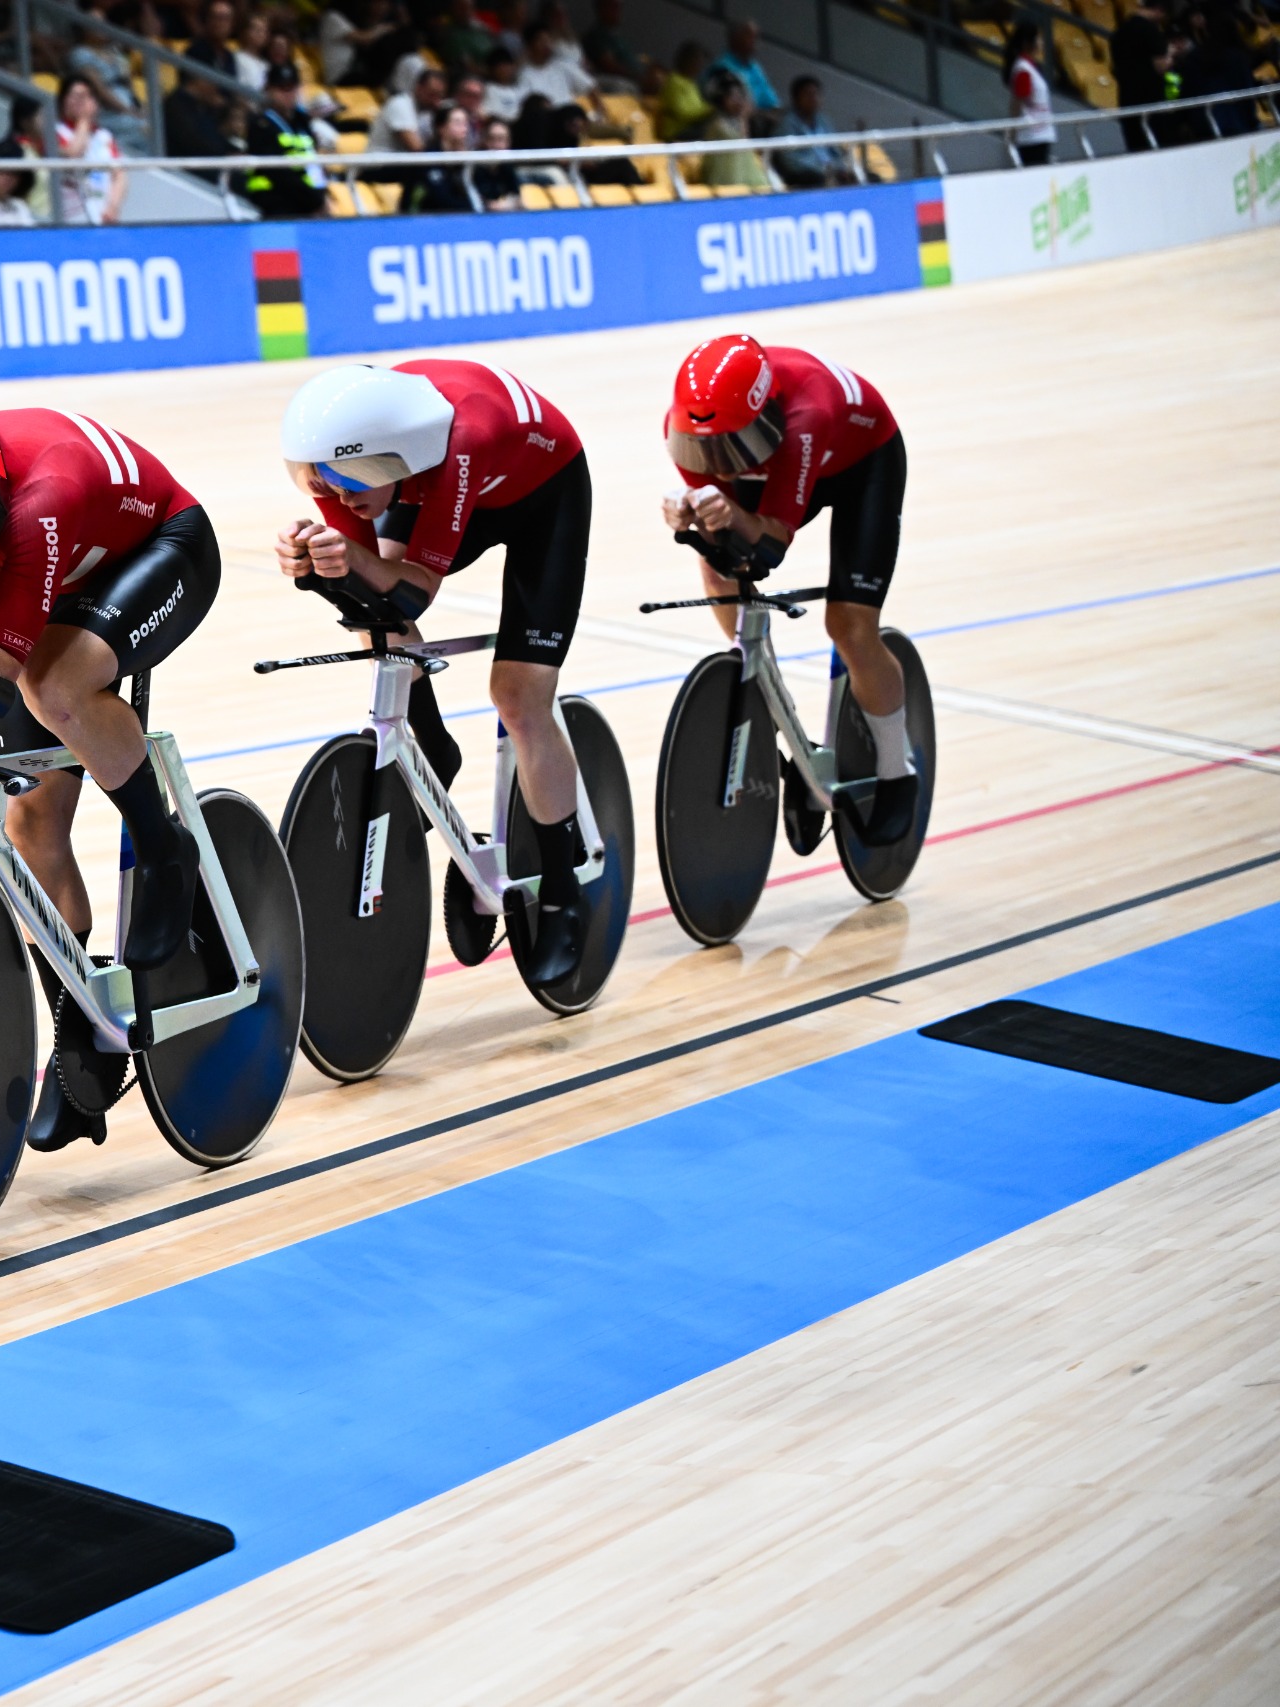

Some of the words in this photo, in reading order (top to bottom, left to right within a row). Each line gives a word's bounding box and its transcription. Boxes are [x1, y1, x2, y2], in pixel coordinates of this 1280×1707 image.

[369, 234, 593, 324] SHIMANO
[696, 208, 877, 293] SHIMANO
[119, 496, 156, 519] postnord
[452, 454, 470, 532] postnord
[38, 517, 60, 613] postnord
[3, 632, 26, 649] TEAM
[78, 603, 113, 621] DENMARK
[106, 604, 122, 618] FOR
[129, 579, 184, 649] postnord
[528, 638, 558, 648] DENMARK
[364, 826, 377, 892] CANYON
